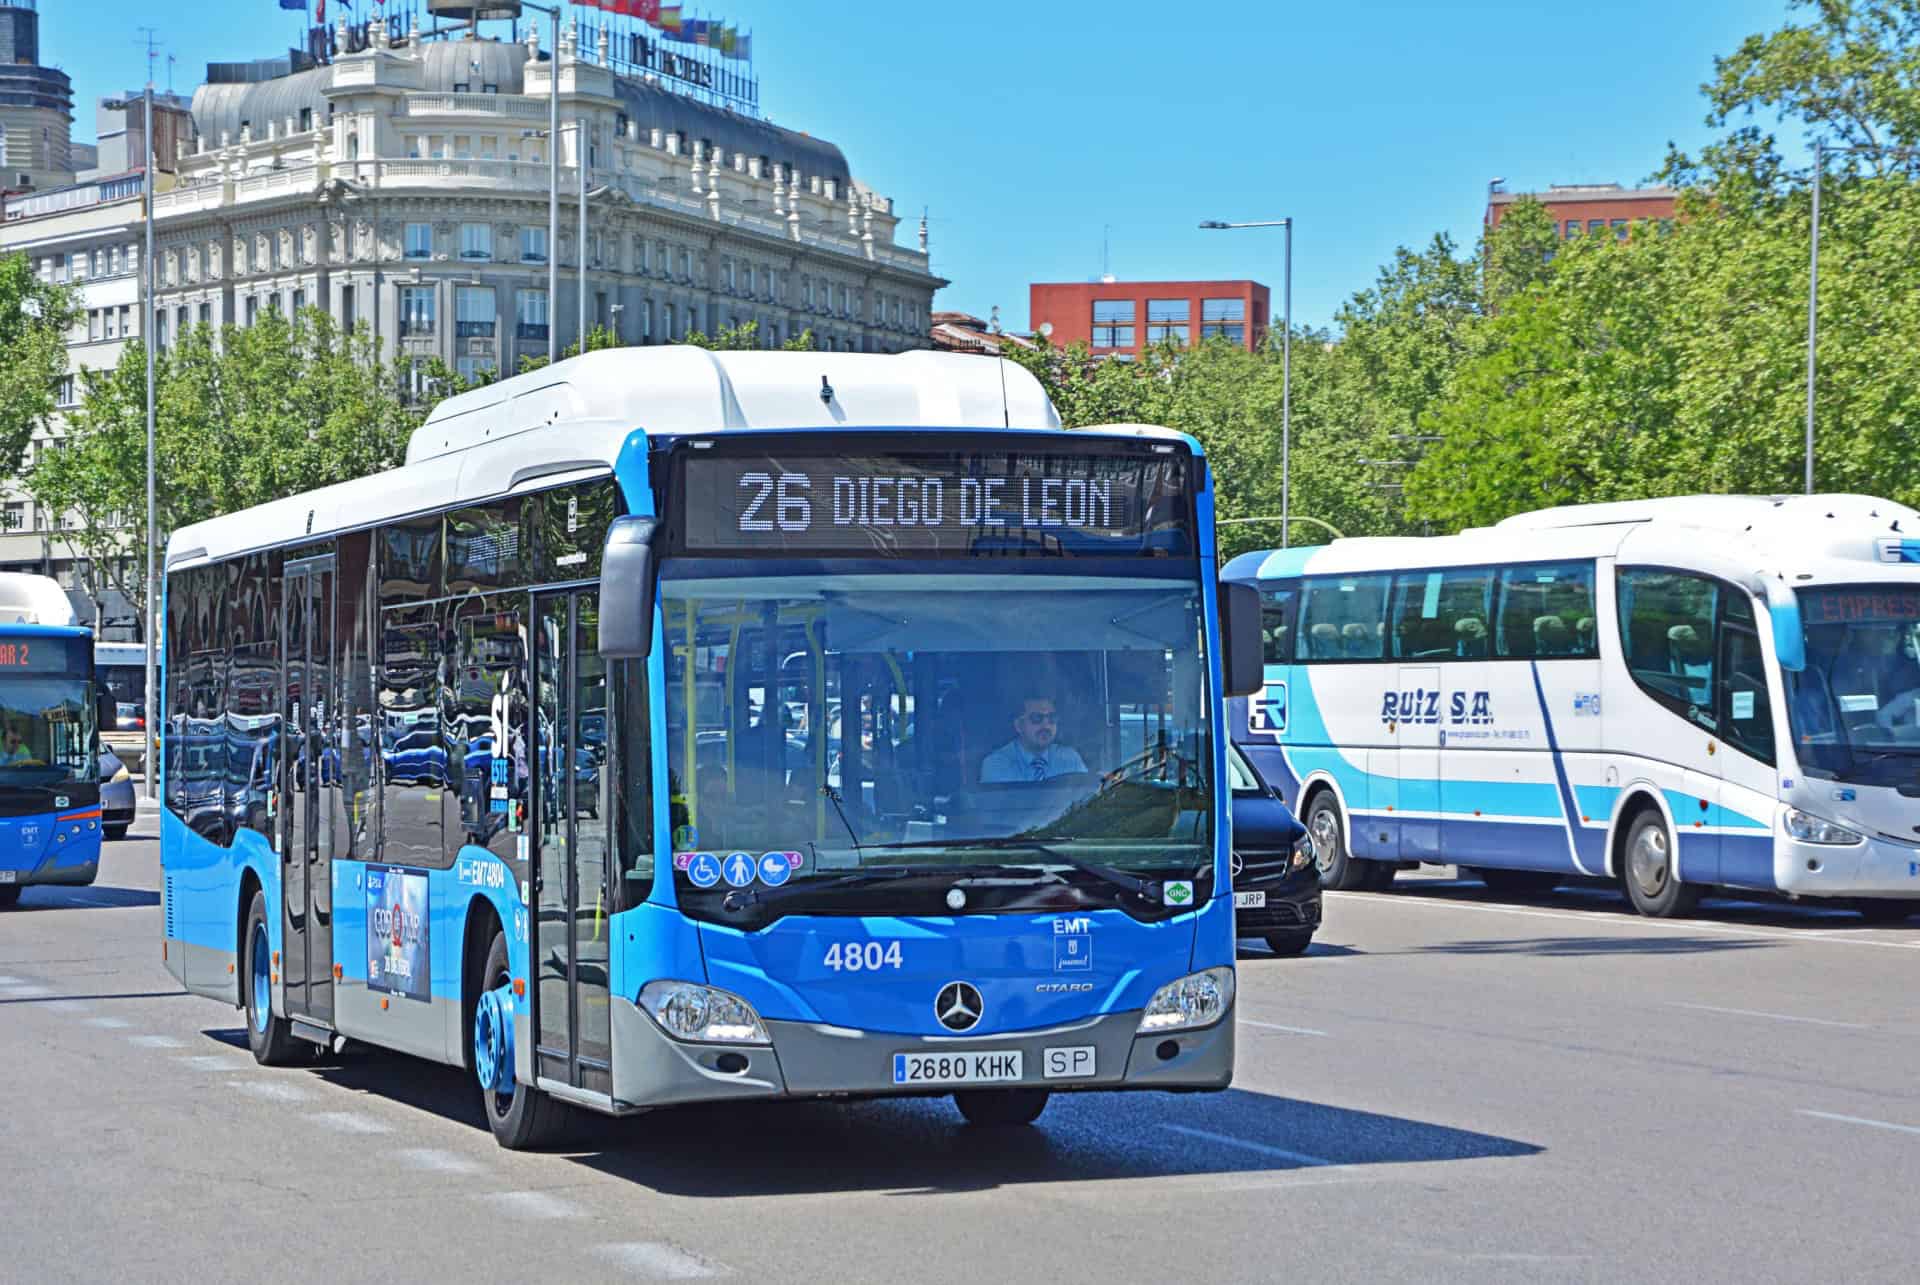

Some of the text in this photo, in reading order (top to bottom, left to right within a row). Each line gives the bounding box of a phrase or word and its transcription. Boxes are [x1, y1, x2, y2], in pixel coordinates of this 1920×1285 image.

[739, 473, 1111, 531] 26 DIEGO DE LEON
[20, 643, 29, 665] 2
[1168, 888, 1190, 898] GNC
[1242, 894, 1263, 905] JRP
[1053, 918, 1090, 935] EMT
[823, 941, 904, 972] 4804
[1035, 983, 1093, 993] CITARO
[909, 1055, 1018, 1080] 2680 KHK
[1051, 1050, 1090, 1073] SP
